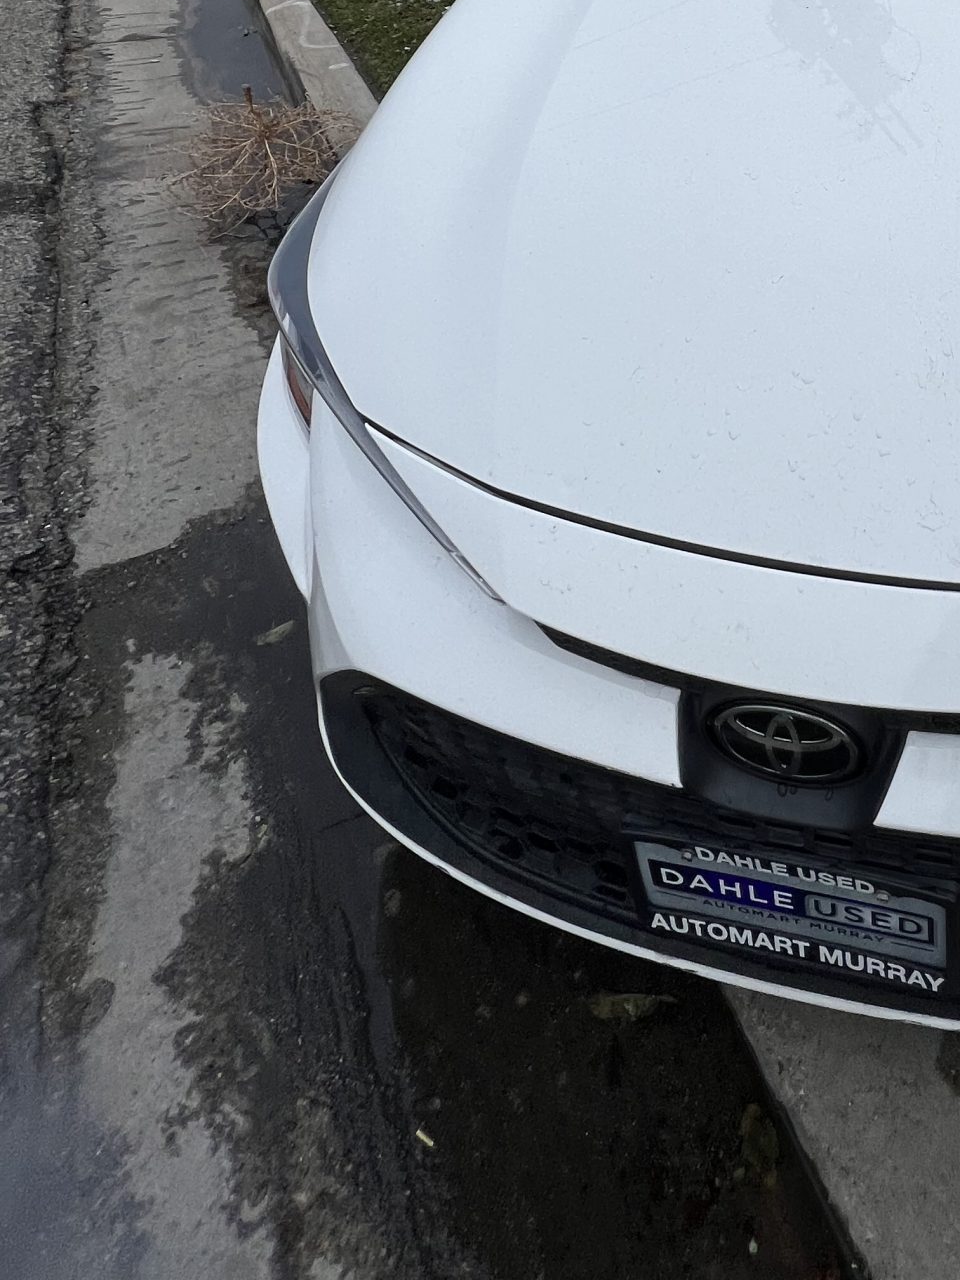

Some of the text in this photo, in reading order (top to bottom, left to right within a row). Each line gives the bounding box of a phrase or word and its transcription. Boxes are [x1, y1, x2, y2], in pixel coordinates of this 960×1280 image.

[694, 846, 875, 895] DAHLE USED
[660, 867, 923, 936] DAHLE USED
[702, 899, 885, 943] AUTOMART MURRAY
[651, 913, 945, 993] AUTOMART MURRAY
